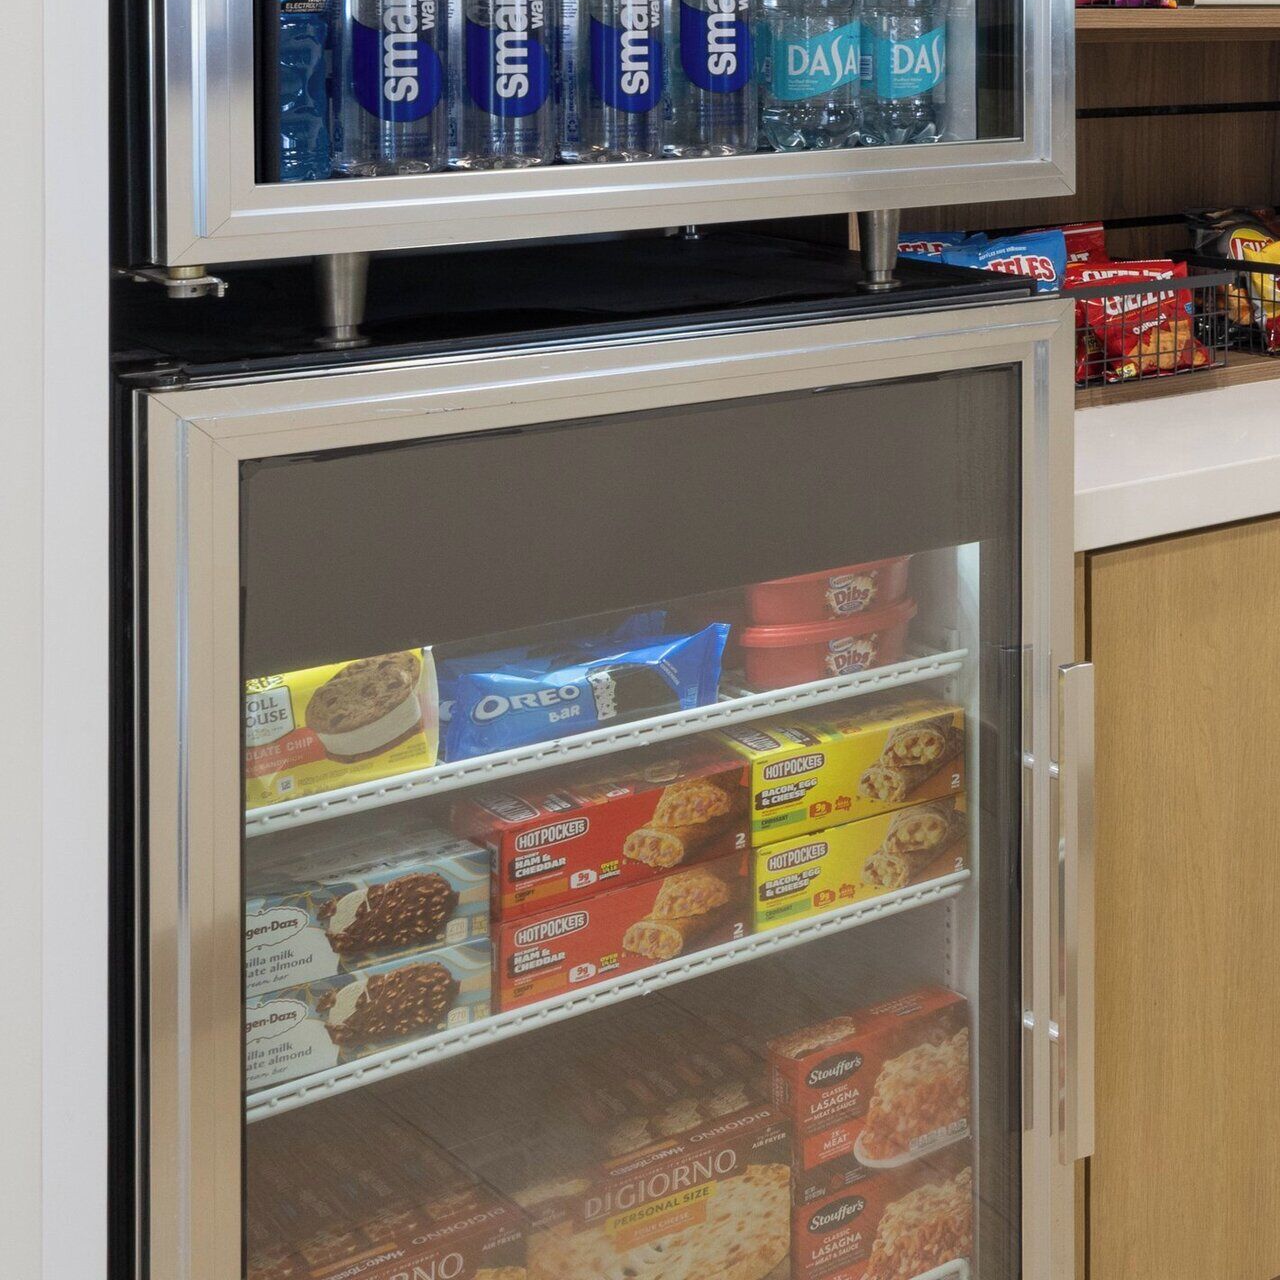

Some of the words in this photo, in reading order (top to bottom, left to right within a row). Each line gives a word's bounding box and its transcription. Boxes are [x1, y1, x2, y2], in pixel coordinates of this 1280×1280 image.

[833, 587, 872, 607] Dibs
[832, 647, 872, 669] Dibs
[472, 684, 581, 725] OREO
[286, 737, 313, 751] CHIP
[761, 784, 797, 797] BACON,
[771, 790, 805, 803] CHEESE
[515, 856, 541, 870] HAM
[515, 858, 566, 878] CHEDDAR
[765, 874, 800, 888] BACON,
[775, 880, 809, 894] CHEESE
[268, 949, 295, 964] milk
[270, 955, 313, 972] almond
[514, 952, 566, 973] CHEDDAR
[268, 1042, 294, 1058] milk
[268, 1047, 312, 1065] almond
[808, 1056, 862, 1085] Stouffer's
[821, 1084, 849, 1099] CLASSIC
[811, 1089, 860, 1114] LASAGNA
[823, 1134, 847, 1150] MEAT
[613, 1199, 680, 1228] PERSONAL
[683, 1186, 710, 1202] SIZE
[810, 1200, 864, 1228] Stouffer's
[823, 1228, 850, 1244] CLASSIC
[812, 1233, 862, 1259] LASAGNA
